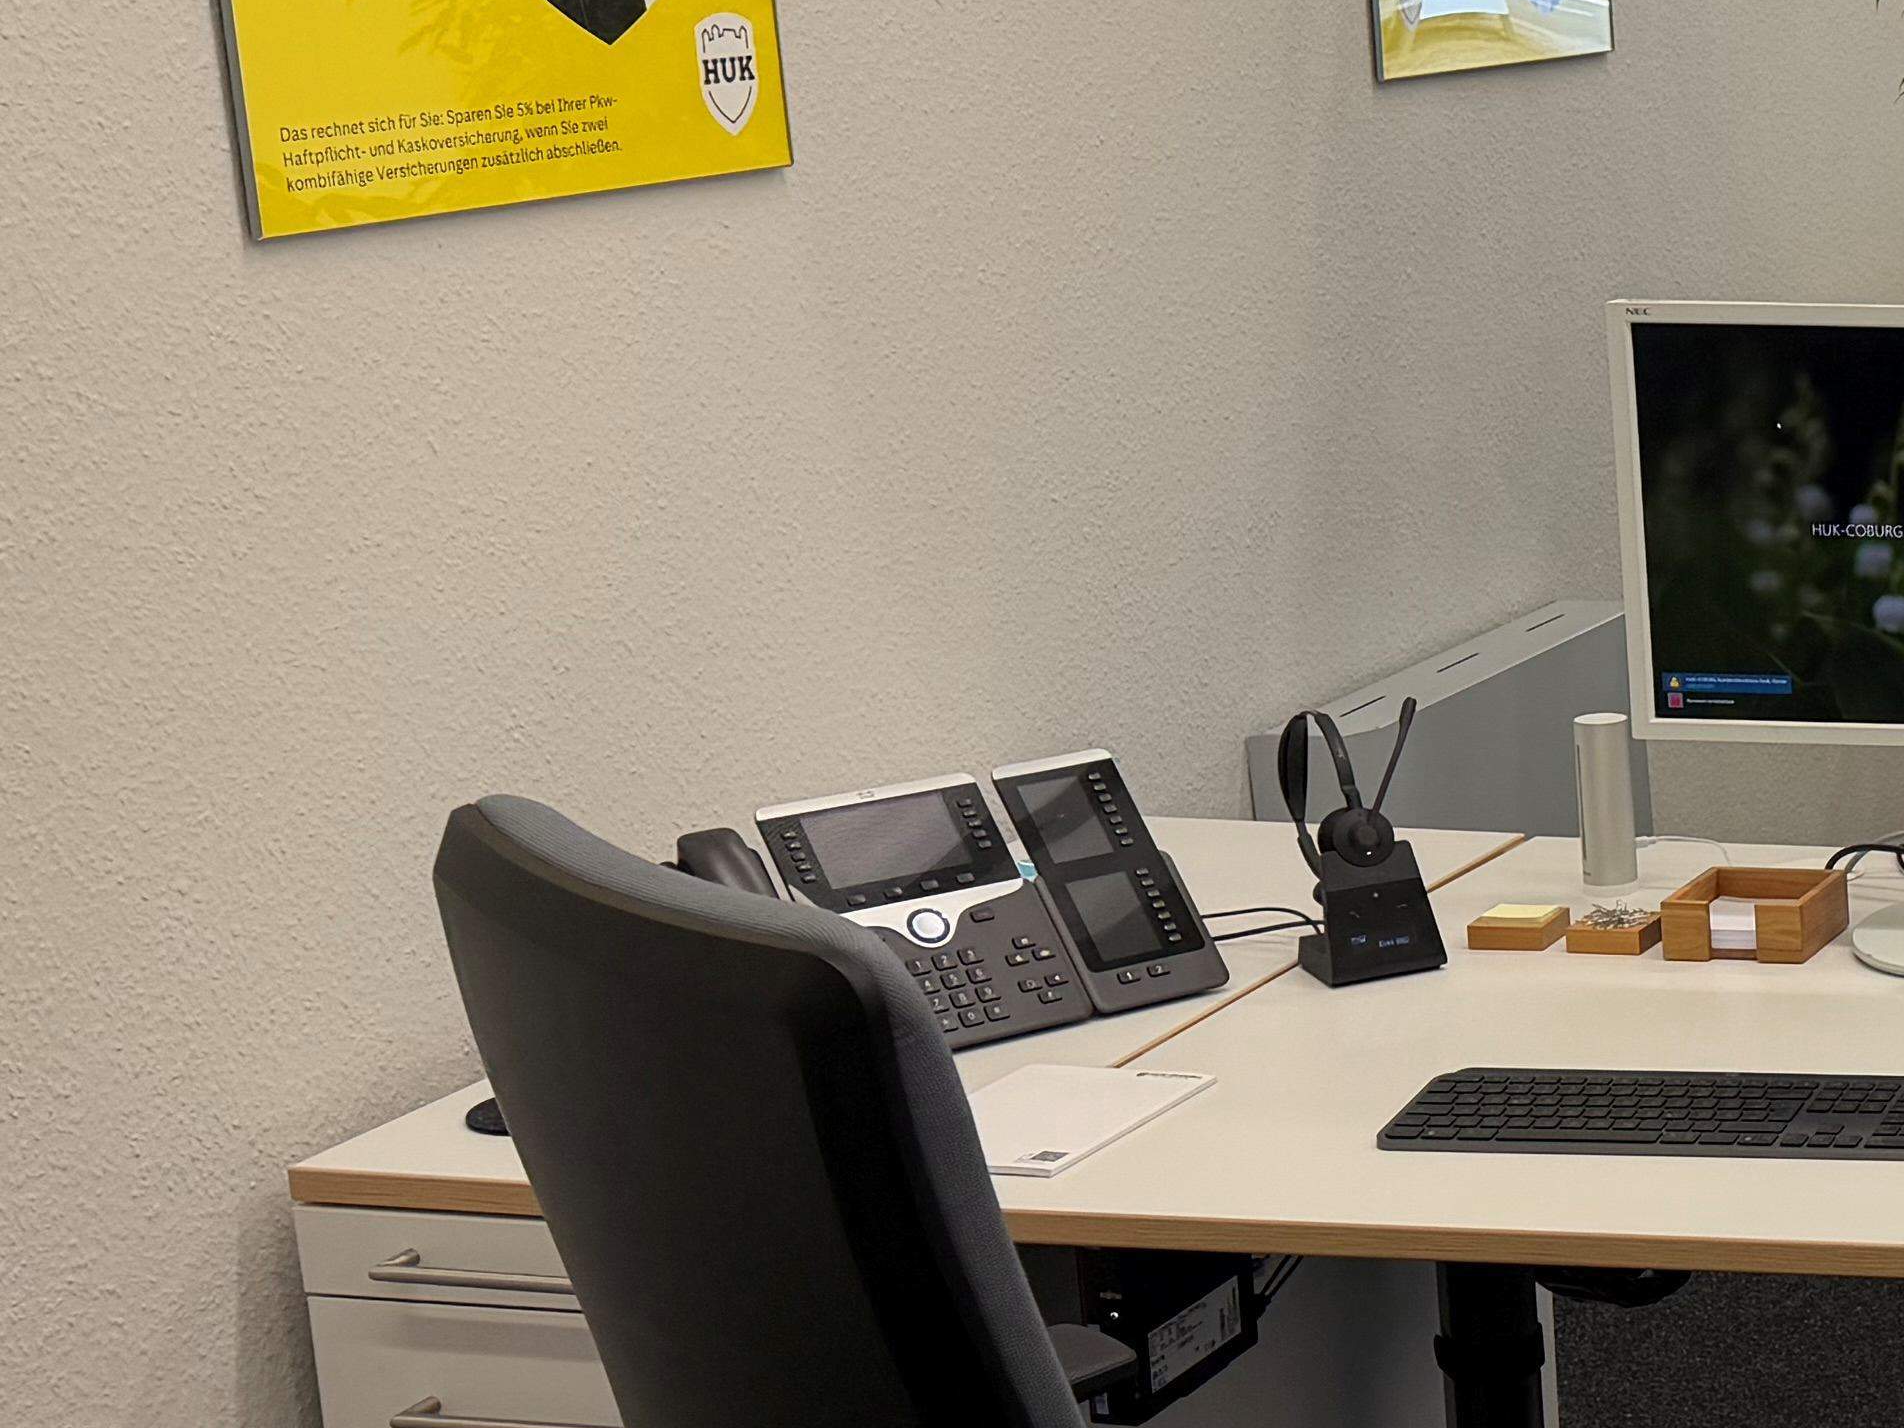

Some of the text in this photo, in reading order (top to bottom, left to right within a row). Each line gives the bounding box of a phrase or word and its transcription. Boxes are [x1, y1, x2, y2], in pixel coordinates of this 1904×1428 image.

[702, 54, 755, 86] HUK
[280, 127, 308, 143] Das
[312, 121, 365, 139] rechnet
[369, 117, 396, 133] sich
[399, 114, 417, 131] für
[420, 112, 444, 128] Sie:
[446, 109, 492, 128] Sparen
[494, 103, 514, 120] Sie
[536, 100, 556, 115] bei
[558, 97, 587, 113] Ihrer
[589, 94, 618, 109] Pkw-
[283, 116, 608, 168] Haftpflicht- und Kaskoversicherung, wenn Sie zwei
[286, 167, 374, 192] kombifähige
[377, 155, 478, 183] Versicherungen
[481, 147, 544, 169] zusätzlich
[1811, 523, 1903, 538] HUK-COBURG
